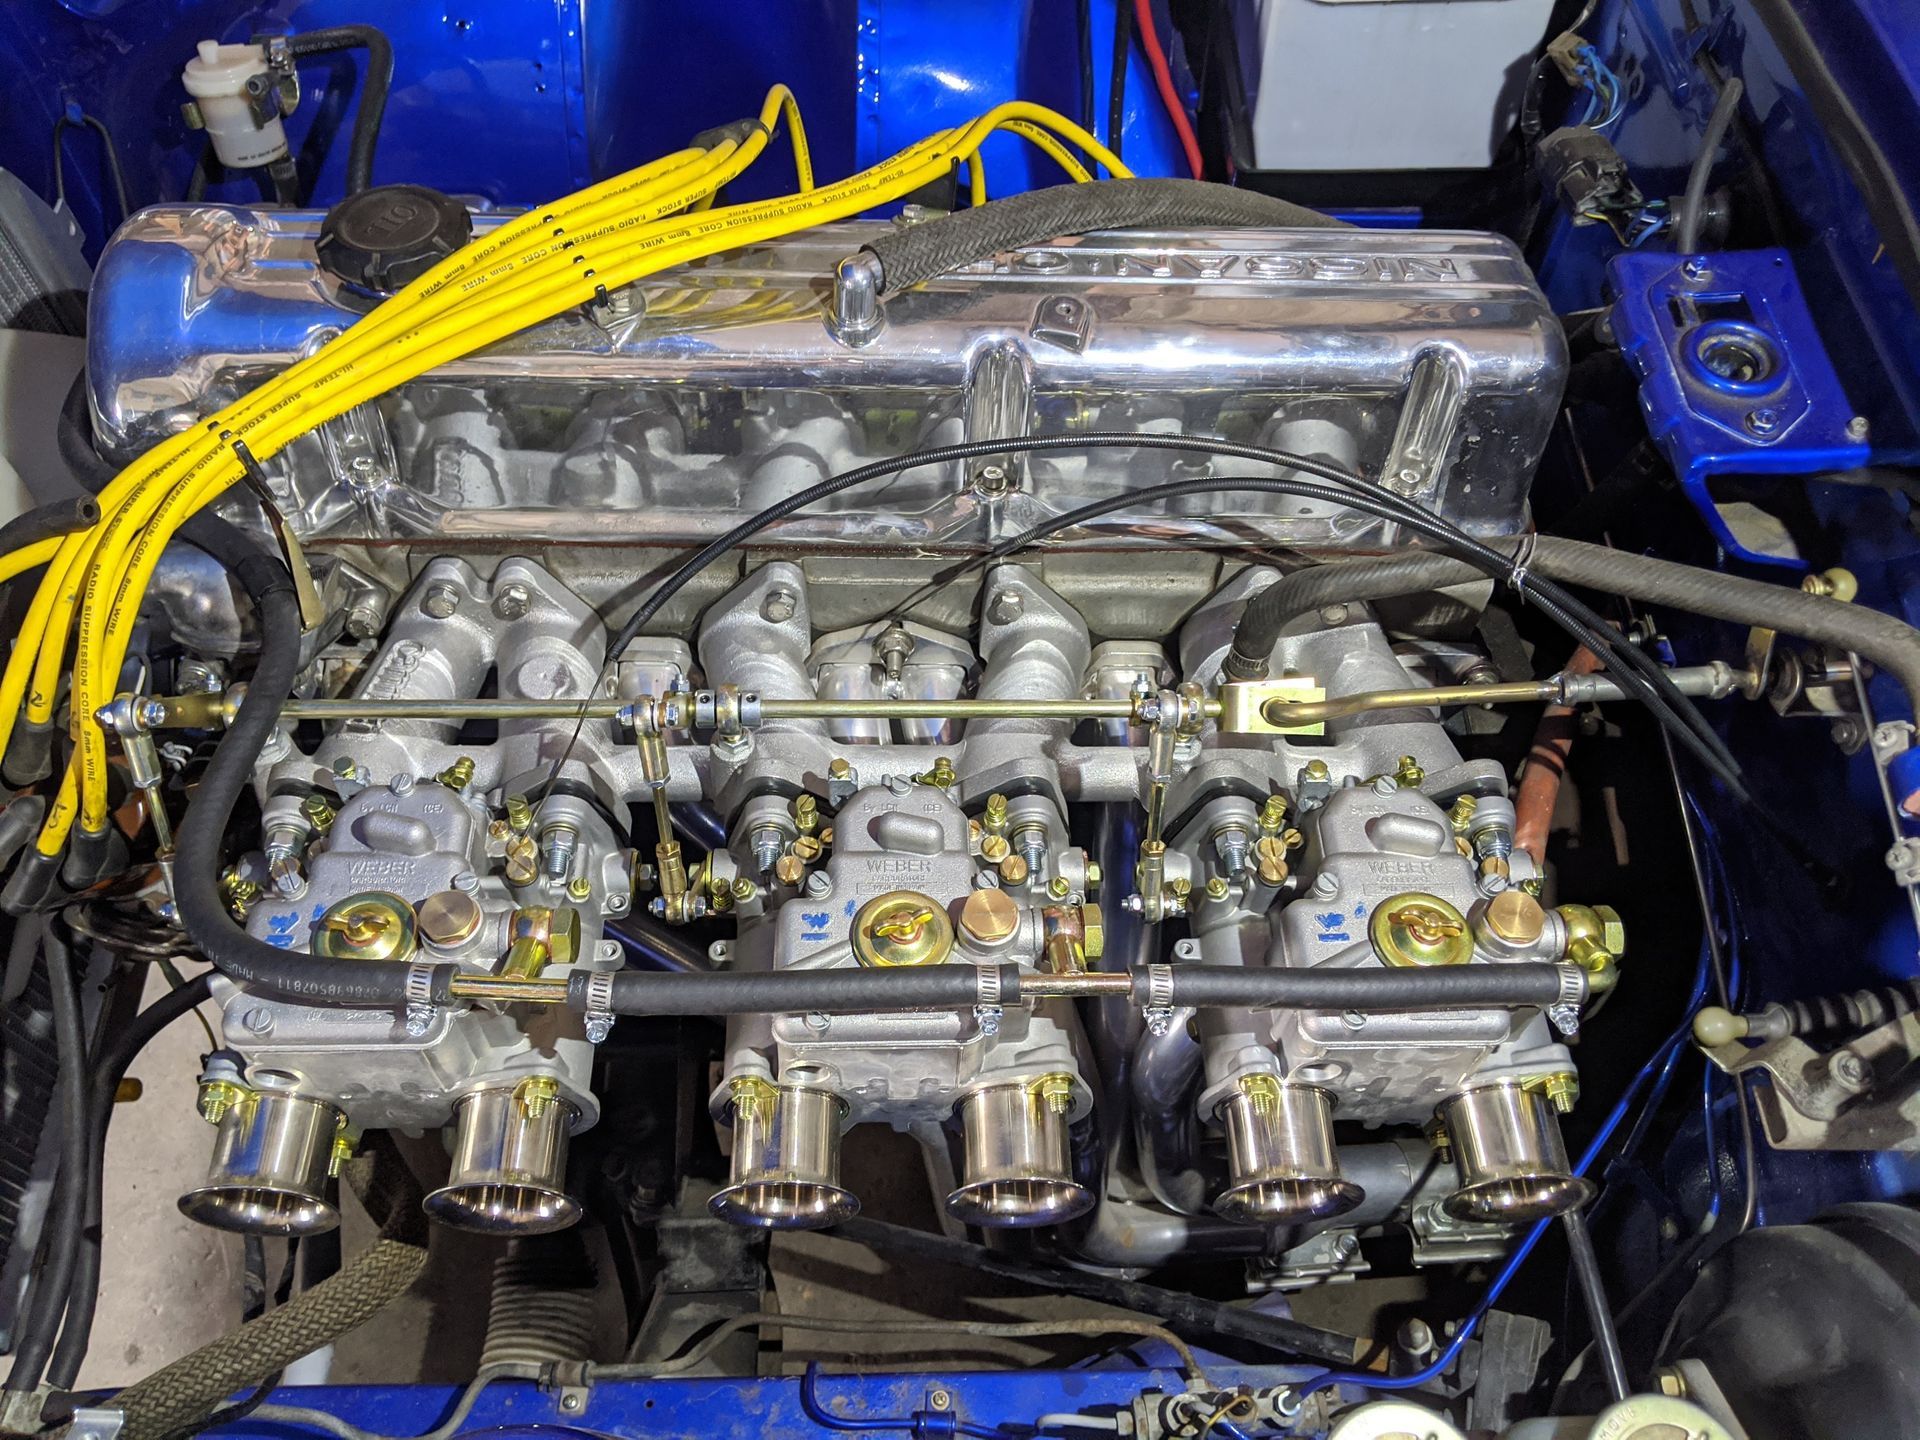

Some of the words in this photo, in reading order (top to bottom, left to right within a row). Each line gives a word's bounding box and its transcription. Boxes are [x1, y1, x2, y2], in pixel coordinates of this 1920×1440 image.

[685, 188, 707, 202] SUPER
[656, 200, 682, 215] STOCK
[726, 207, 785, 227] SUPPRESSION
[788, 201, 813, 214] RADIO
[618, 214, 647, 229] RADIO
[698, 221, 723, 234] CORE
[640, 237, 665, 250] WIRE
[668, 230, 691, 240] 8mm
[473, 246, 497, 264] CORE
[522, 248, 548, 264] CORE
[444, 263, 466, 281] 8mm
[490, 262, 514, 276] 8mm
[1113, 253, 1459, 282] NISSAN
[418, 280, 443, 299] WIRE
[462, 276, 488, 292] WIRE
[313, 364, 355, 389] HI-TEMP
[271, 392, 302, 415] SUPER
[236, 415, 269, 437] STOCK
[195, 443, 226, 471] RADIO
[123, 486, 147, 515] SUPER
[148, 472, 197, 538] SUPPRESSION
[132, 541, 149, 570] CORE
[85, 564, 101, 600] RADIO
[117, 577, 132, 603] 8mm
[107, 606, 122, 636] WIRE
[79, 605, 92, 686] SUPPRESSION
[81, 692, 90, 721] CORE
[84, 730, 92, 754] 8mm
[86, 758, 96, 782] WIRE
[348, 861, 417, 874] WEBER
[866, 859, 932, 872] WEBER
[1368, 861, 1435, 875] WEBER
